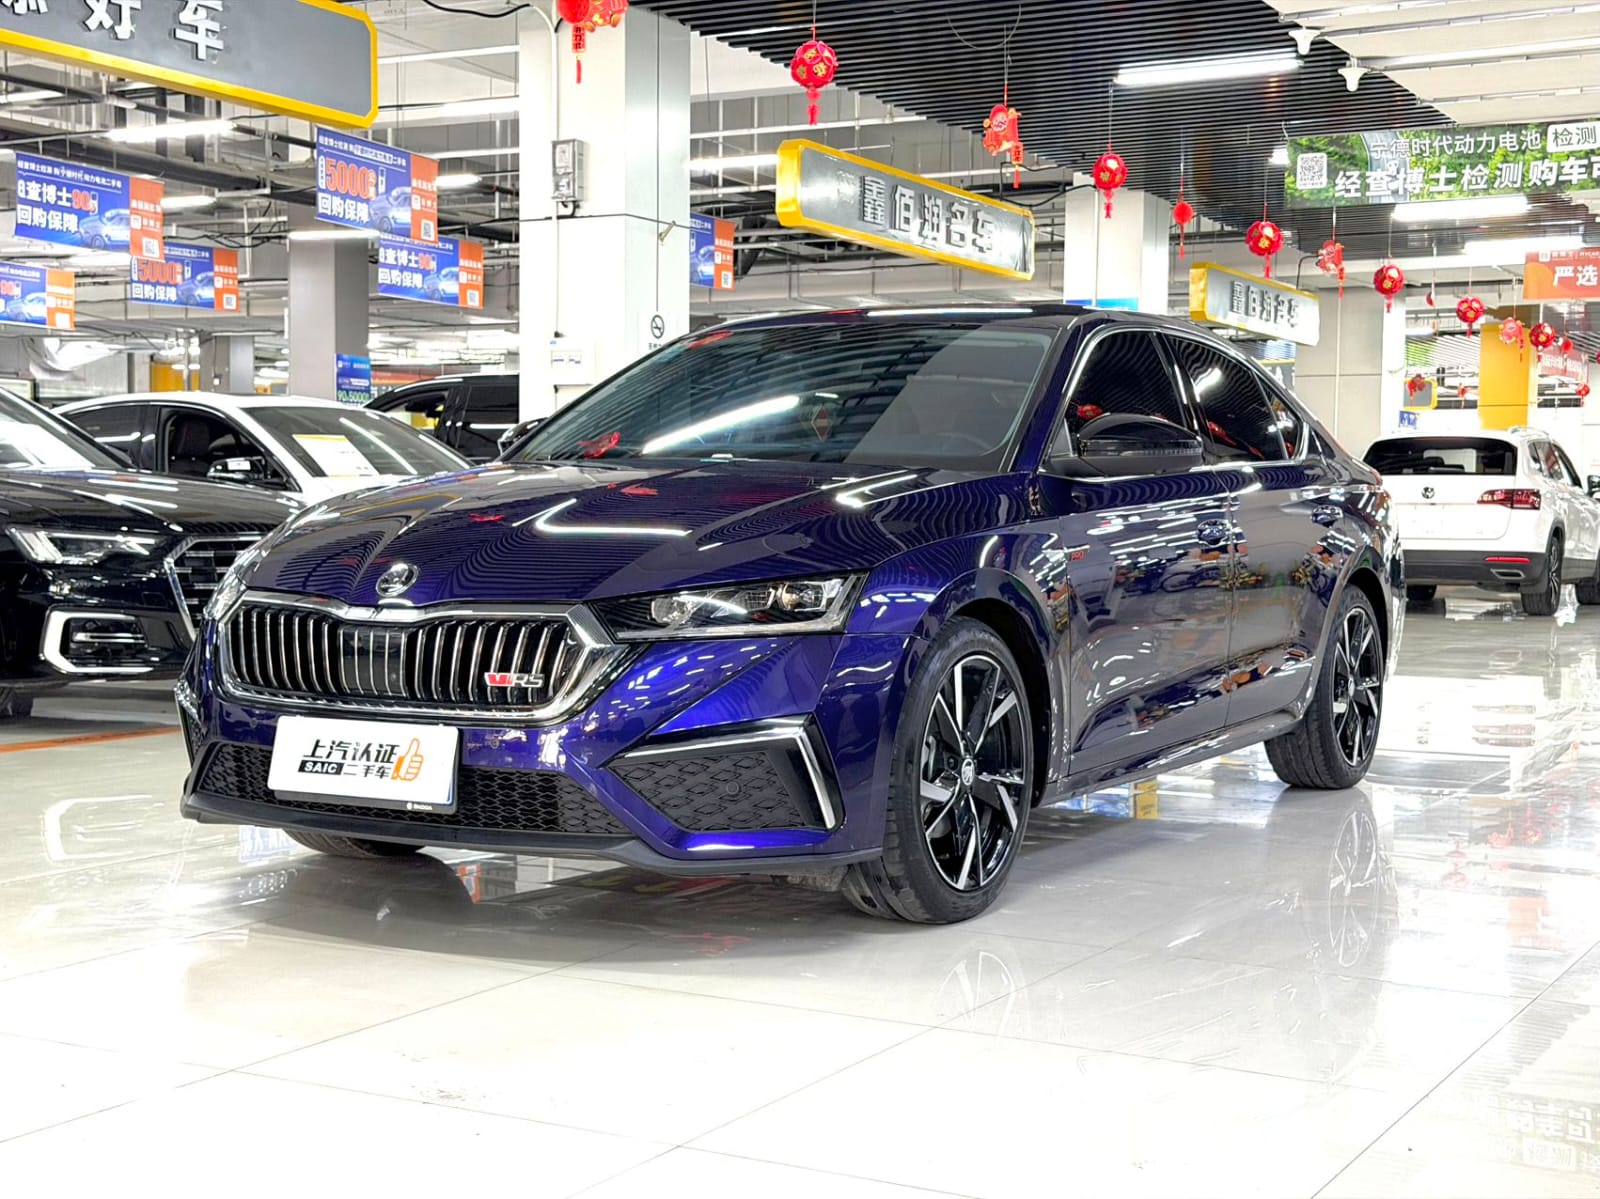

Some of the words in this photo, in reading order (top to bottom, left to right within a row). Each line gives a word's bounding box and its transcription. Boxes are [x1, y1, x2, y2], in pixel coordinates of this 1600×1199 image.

[0, 0, 224, 60] 好车
[1370, 131, 1542, 160] 宁德时代动力电池
[1552, 125, 1597, 148] 检测
[16, 204, 79, 233] 回购保障
[318, 192, 369, 224] 回购保障
[1553, 265, 1598, 287] 严选
[302, 739, 400, 764] 上汽认证
[304, 761, 338, 774] SAIC
[343, 764, 392, 779] 二手车
